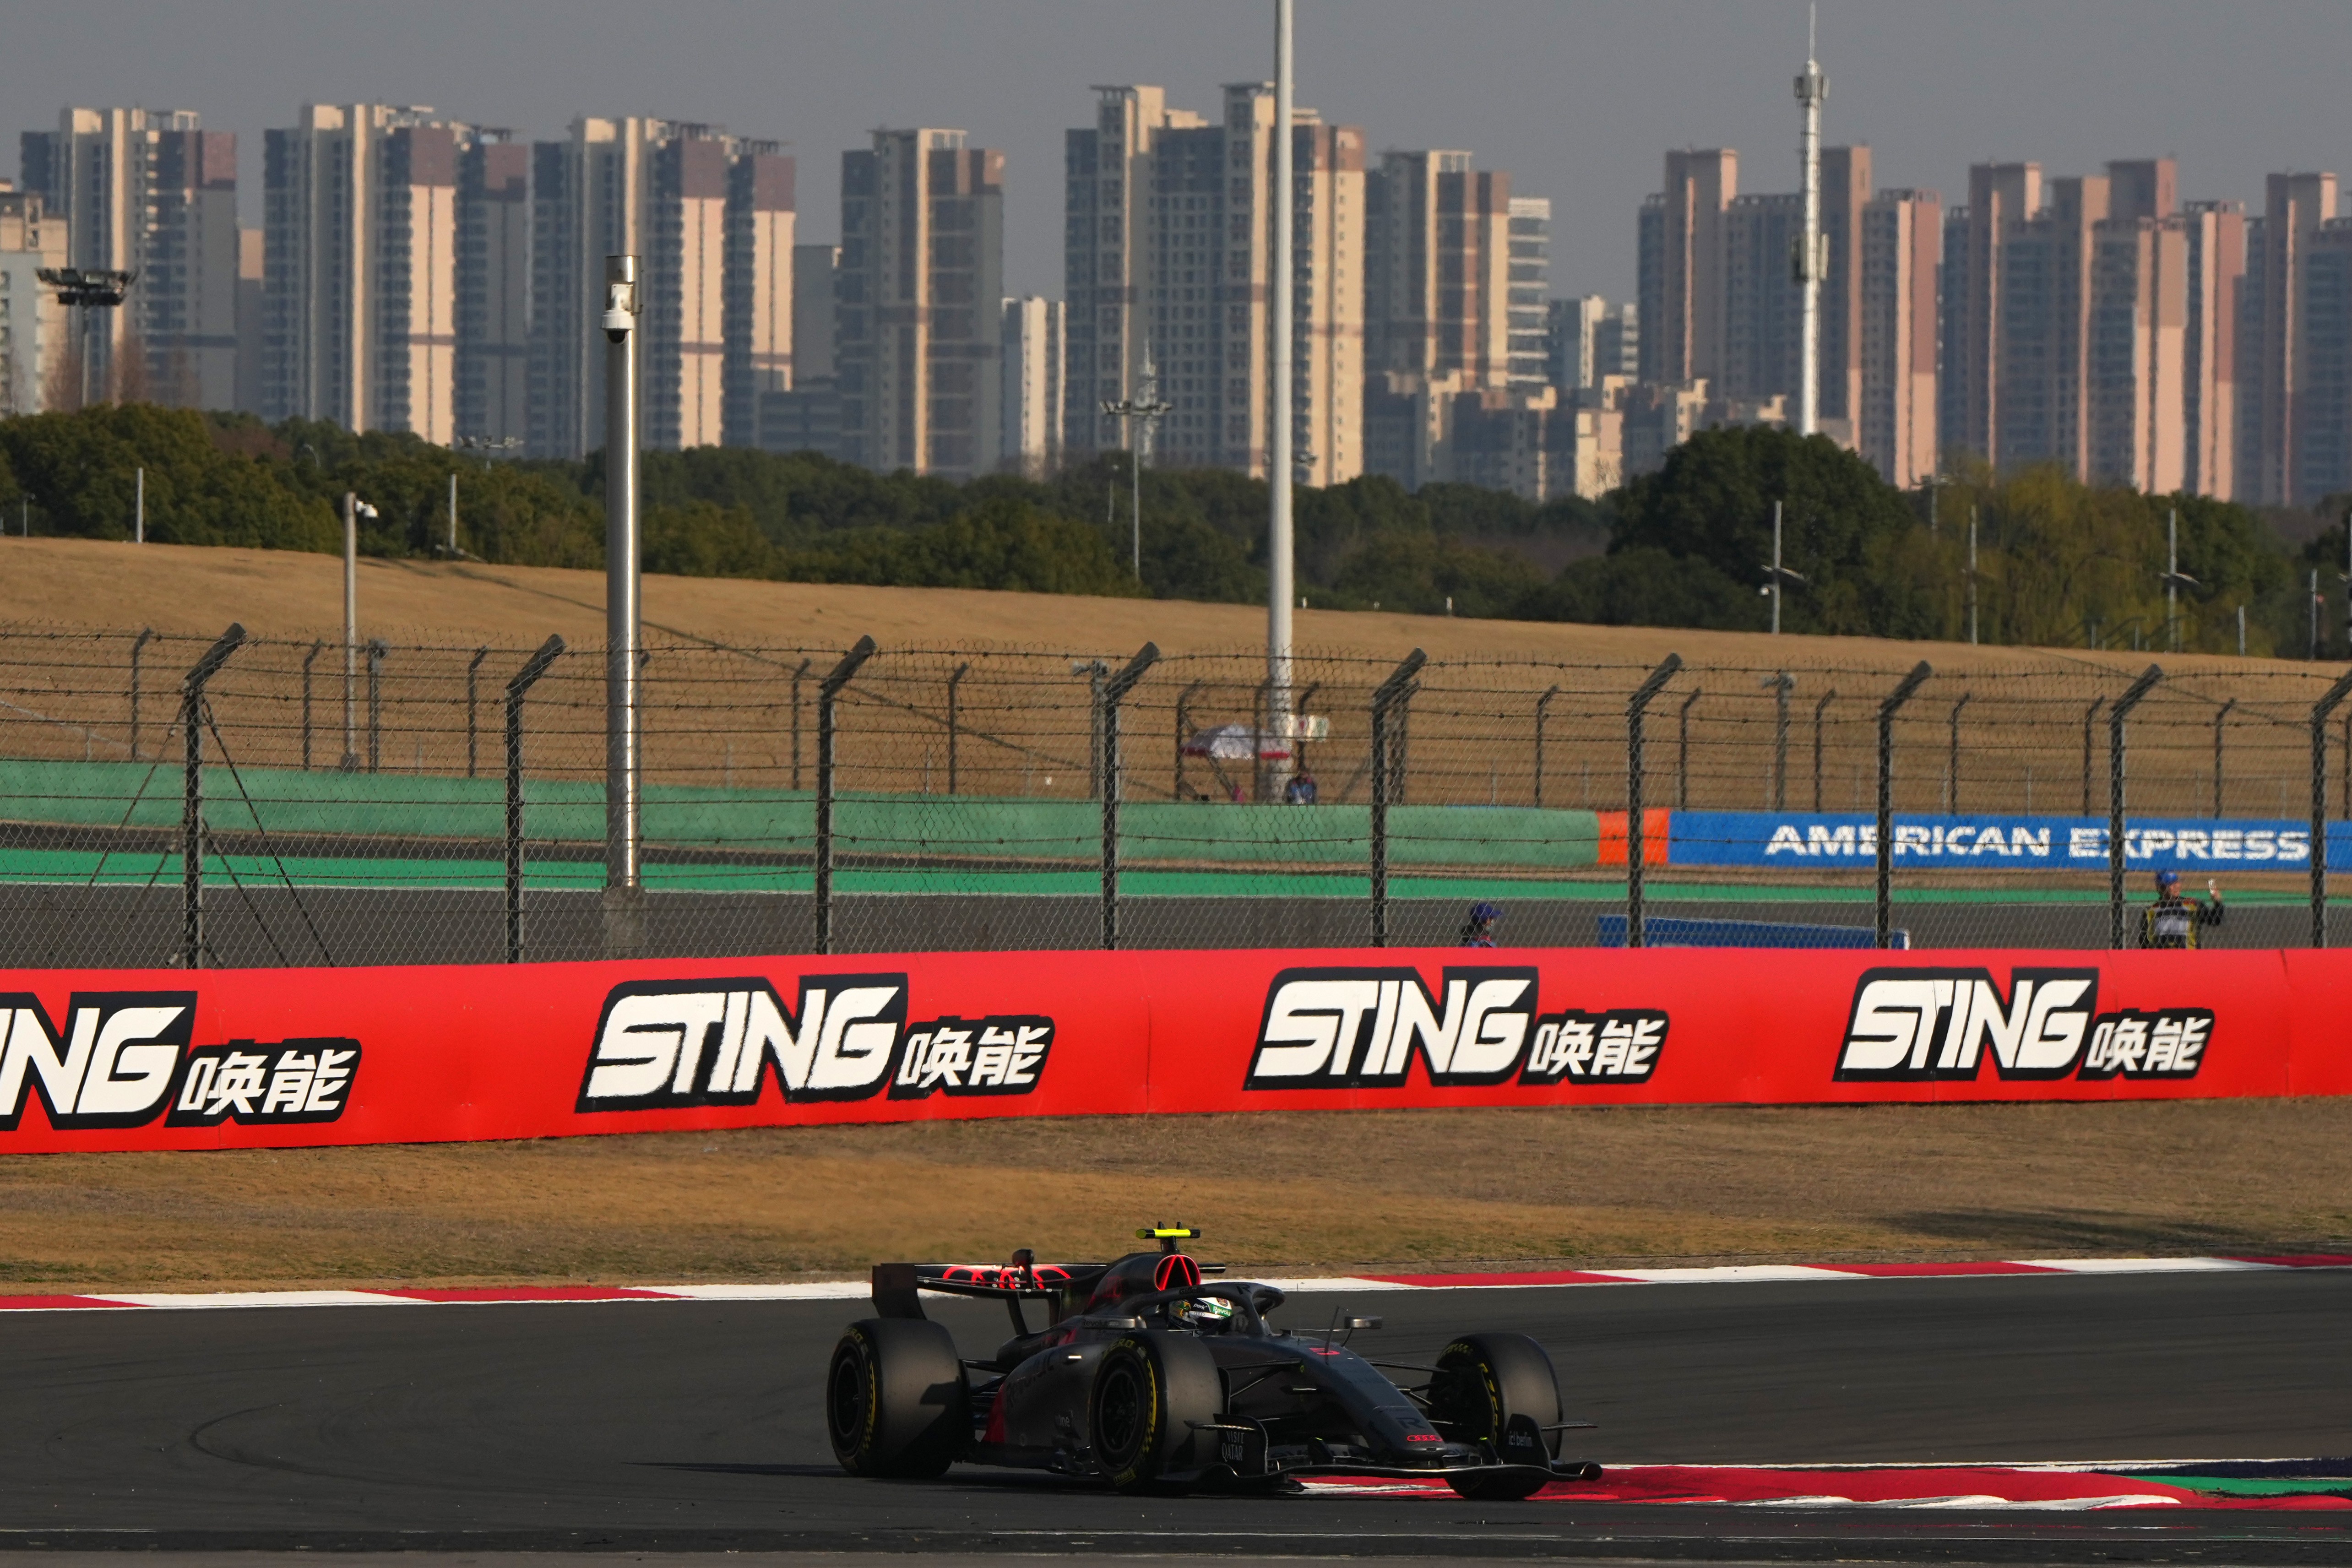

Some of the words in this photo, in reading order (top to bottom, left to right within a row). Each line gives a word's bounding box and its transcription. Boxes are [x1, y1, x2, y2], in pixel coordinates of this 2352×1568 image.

[1765, 825, 2051, 856] AMERICAN
[2069, 828, 2310, 861] EXPRESS
[587, 986, 899, 1098] STING
[1254, 980, 1531, 1076] STING
[1527, 1019, 1665, 1075] 唤能
[1841, 980, 2091, 1069] STING
[2086, 1017, 2211, 1071] 唤能
[0, 1007, 186, 1115] NG
[177, 1049, 356, 1115] 唤能
[896, 1026, 1050, 1088] 唤能
[1213, 1306, 1232, 1317] Revolu
[1222, 1443, 1243, 1463] QATAR
[1226, 1430, 1245, 1444] VISIT
